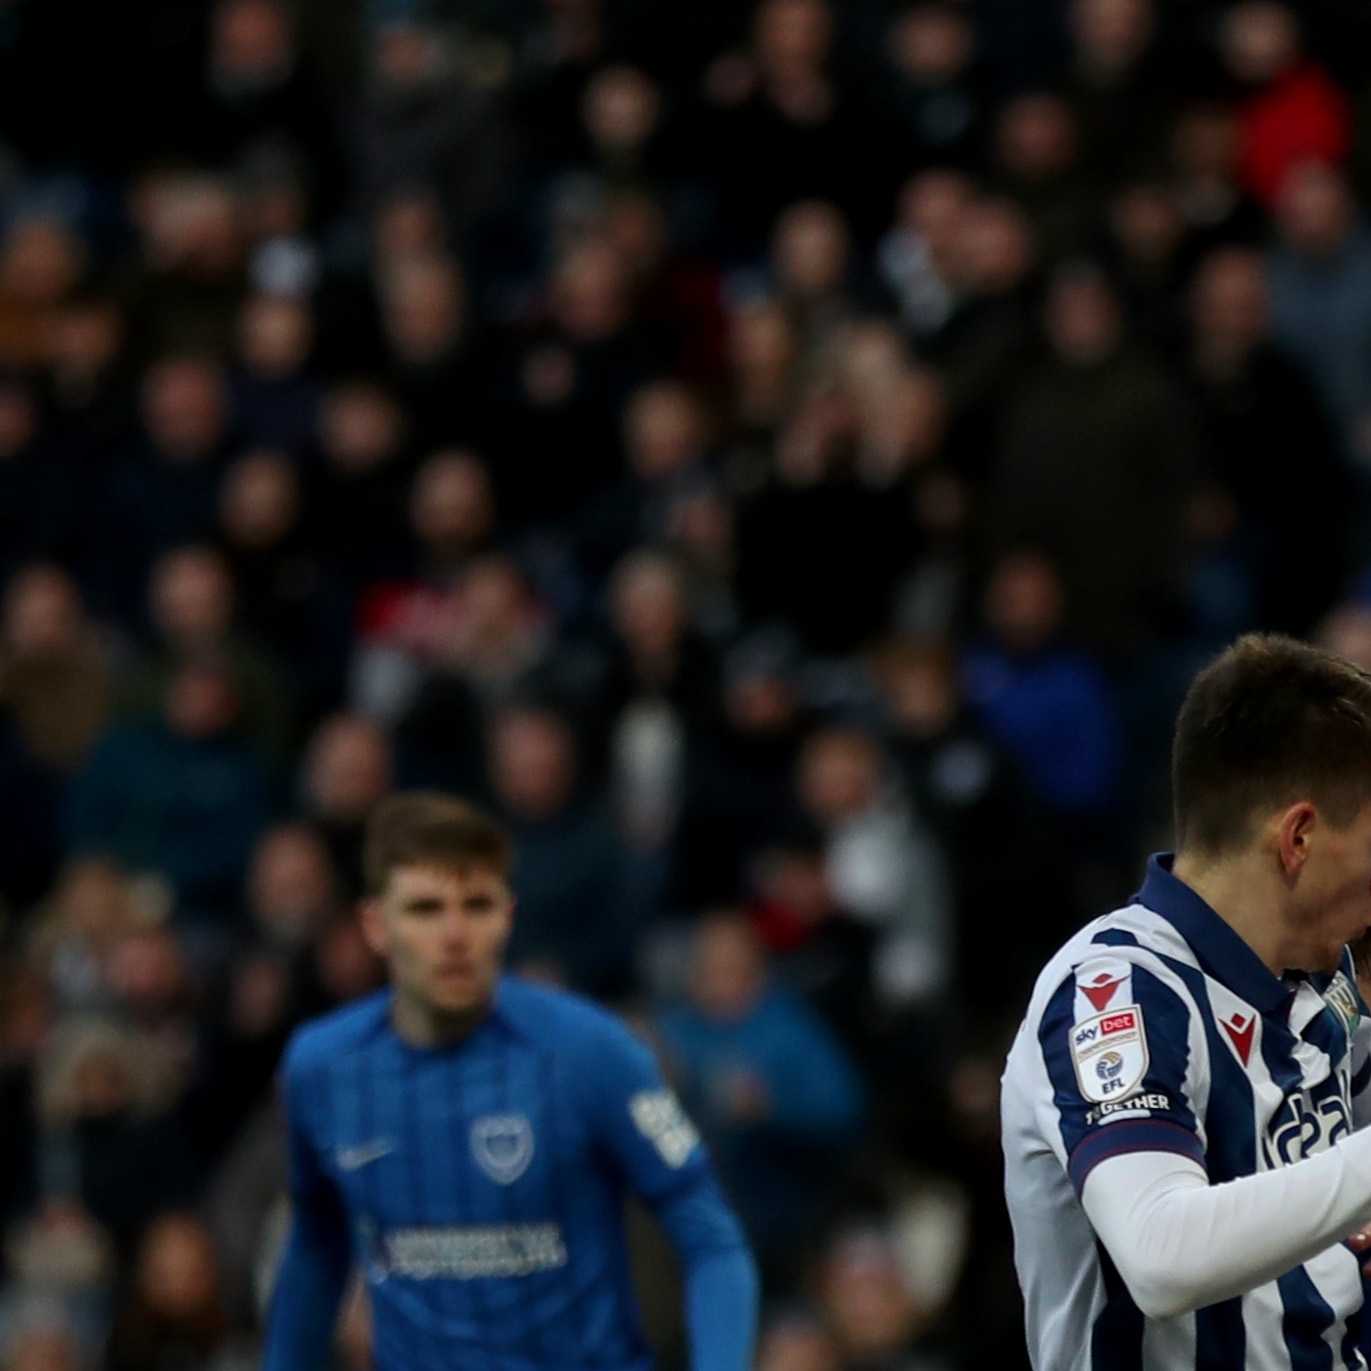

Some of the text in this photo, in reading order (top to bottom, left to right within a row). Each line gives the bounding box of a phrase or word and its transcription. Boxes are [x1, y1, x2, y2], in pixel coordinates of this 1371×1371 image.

[1075, 1026, 1099, 1045] sky
[1102, 1015, 1132, 1032] bet
[1101, 1079, 1126, 1095] EFL
